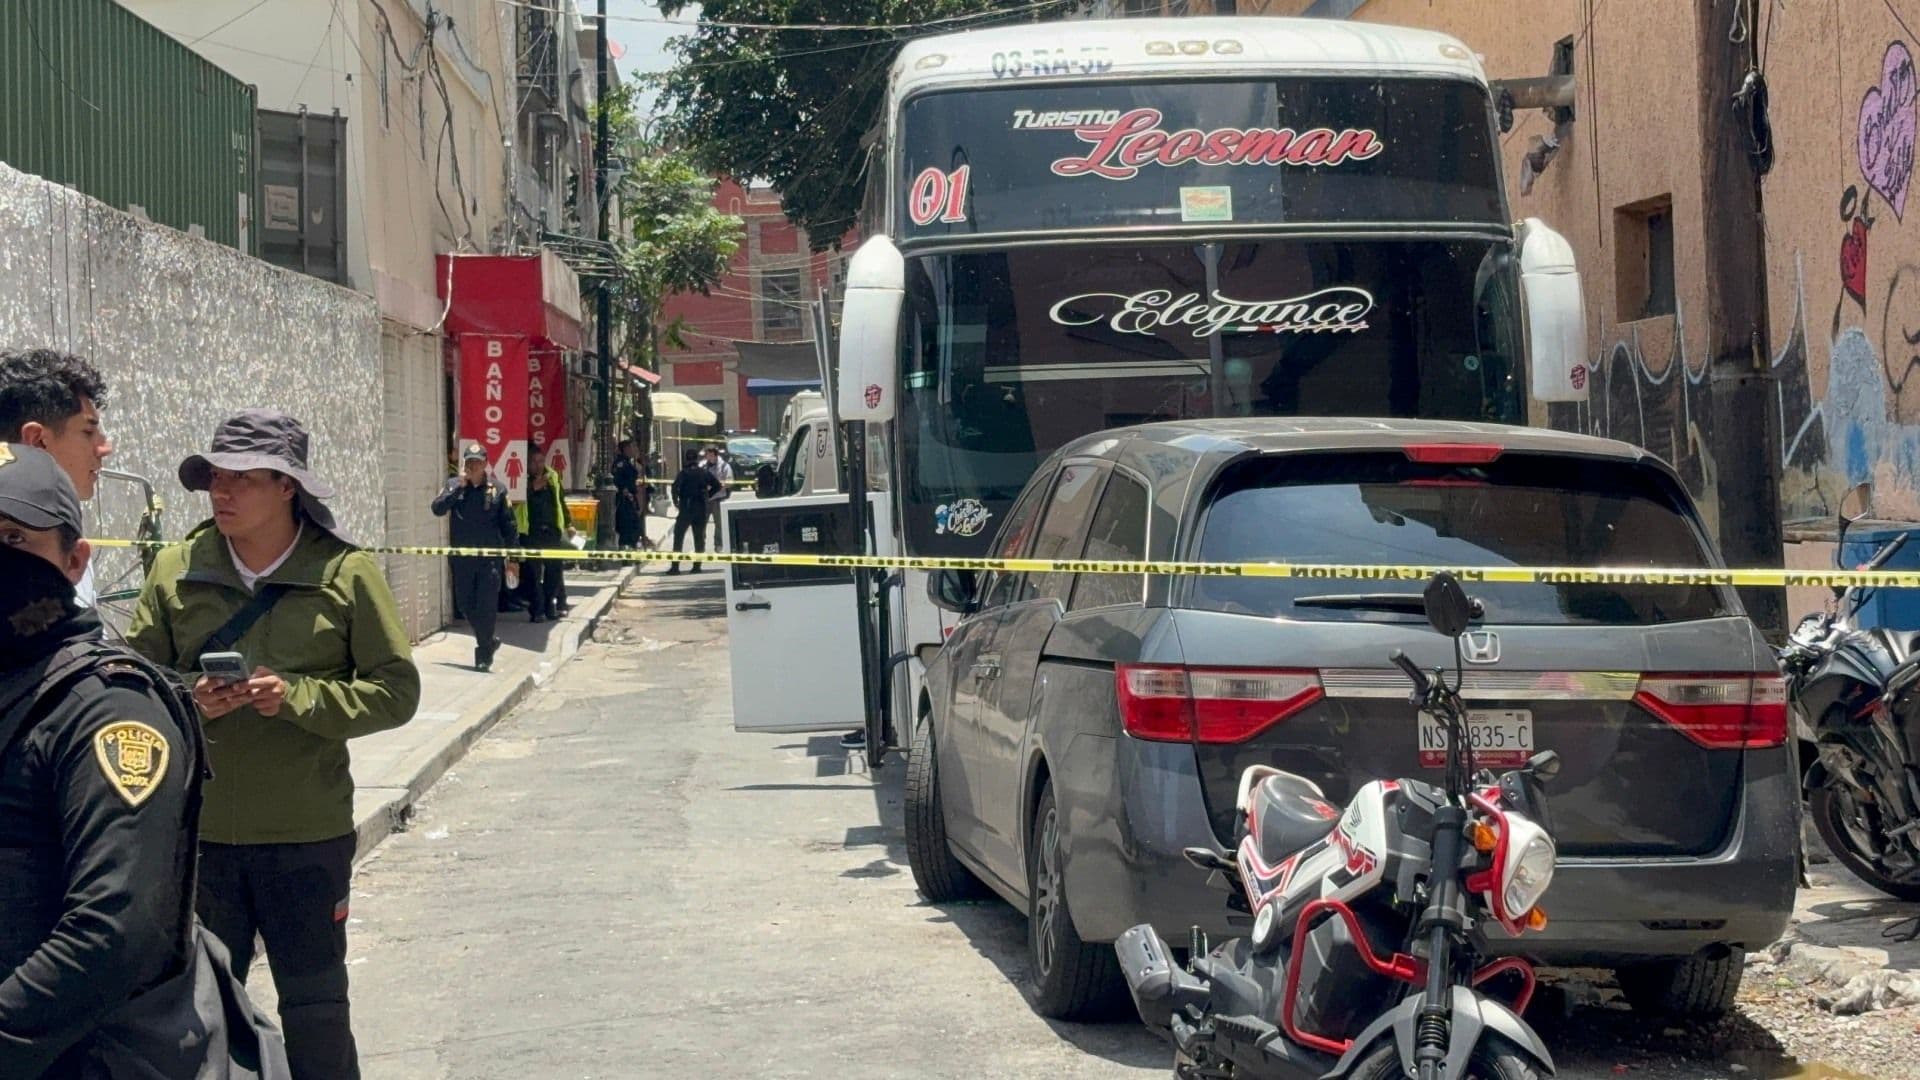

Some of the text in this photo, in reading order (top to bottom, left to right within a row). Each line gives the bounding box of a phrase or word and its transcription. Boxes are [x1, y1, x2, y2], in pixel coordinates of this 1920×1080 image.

[1013, 108, 1382, 180] TURISMO Leosman
[909, 164, 970, 226] 01
[1050, 286, 1373, 337] Elegance
[485, 340, 503, 445] BAÑOS
[528, 358, 546, 445] BAÑOS
